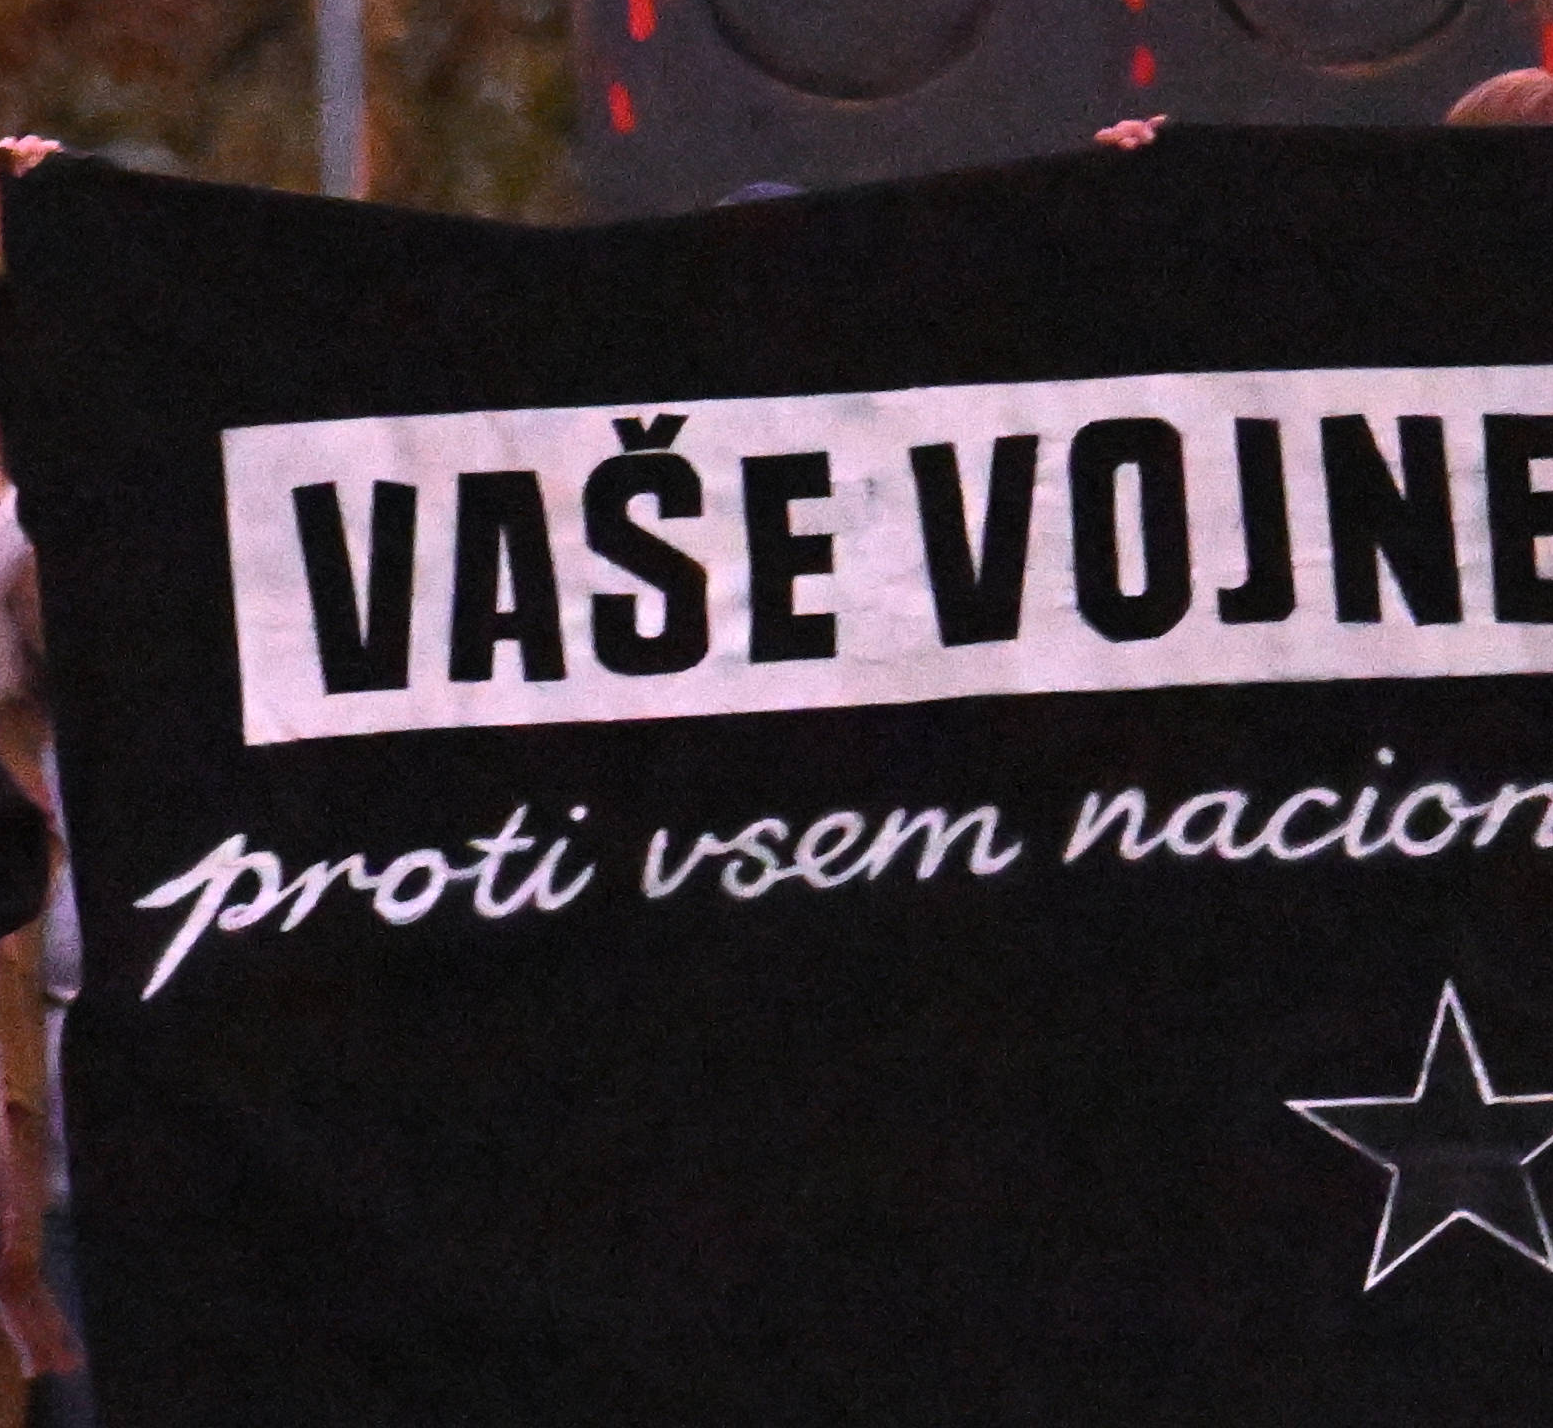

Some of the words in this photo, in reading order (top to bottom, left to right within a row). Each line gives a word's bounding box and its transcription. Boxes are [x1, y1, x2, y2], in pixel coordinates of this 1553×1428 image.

[292, 412, 839, 695] VAŠE
[133, 803, 596, 1001] proti
[641, 800, 1022, 900] vsem
